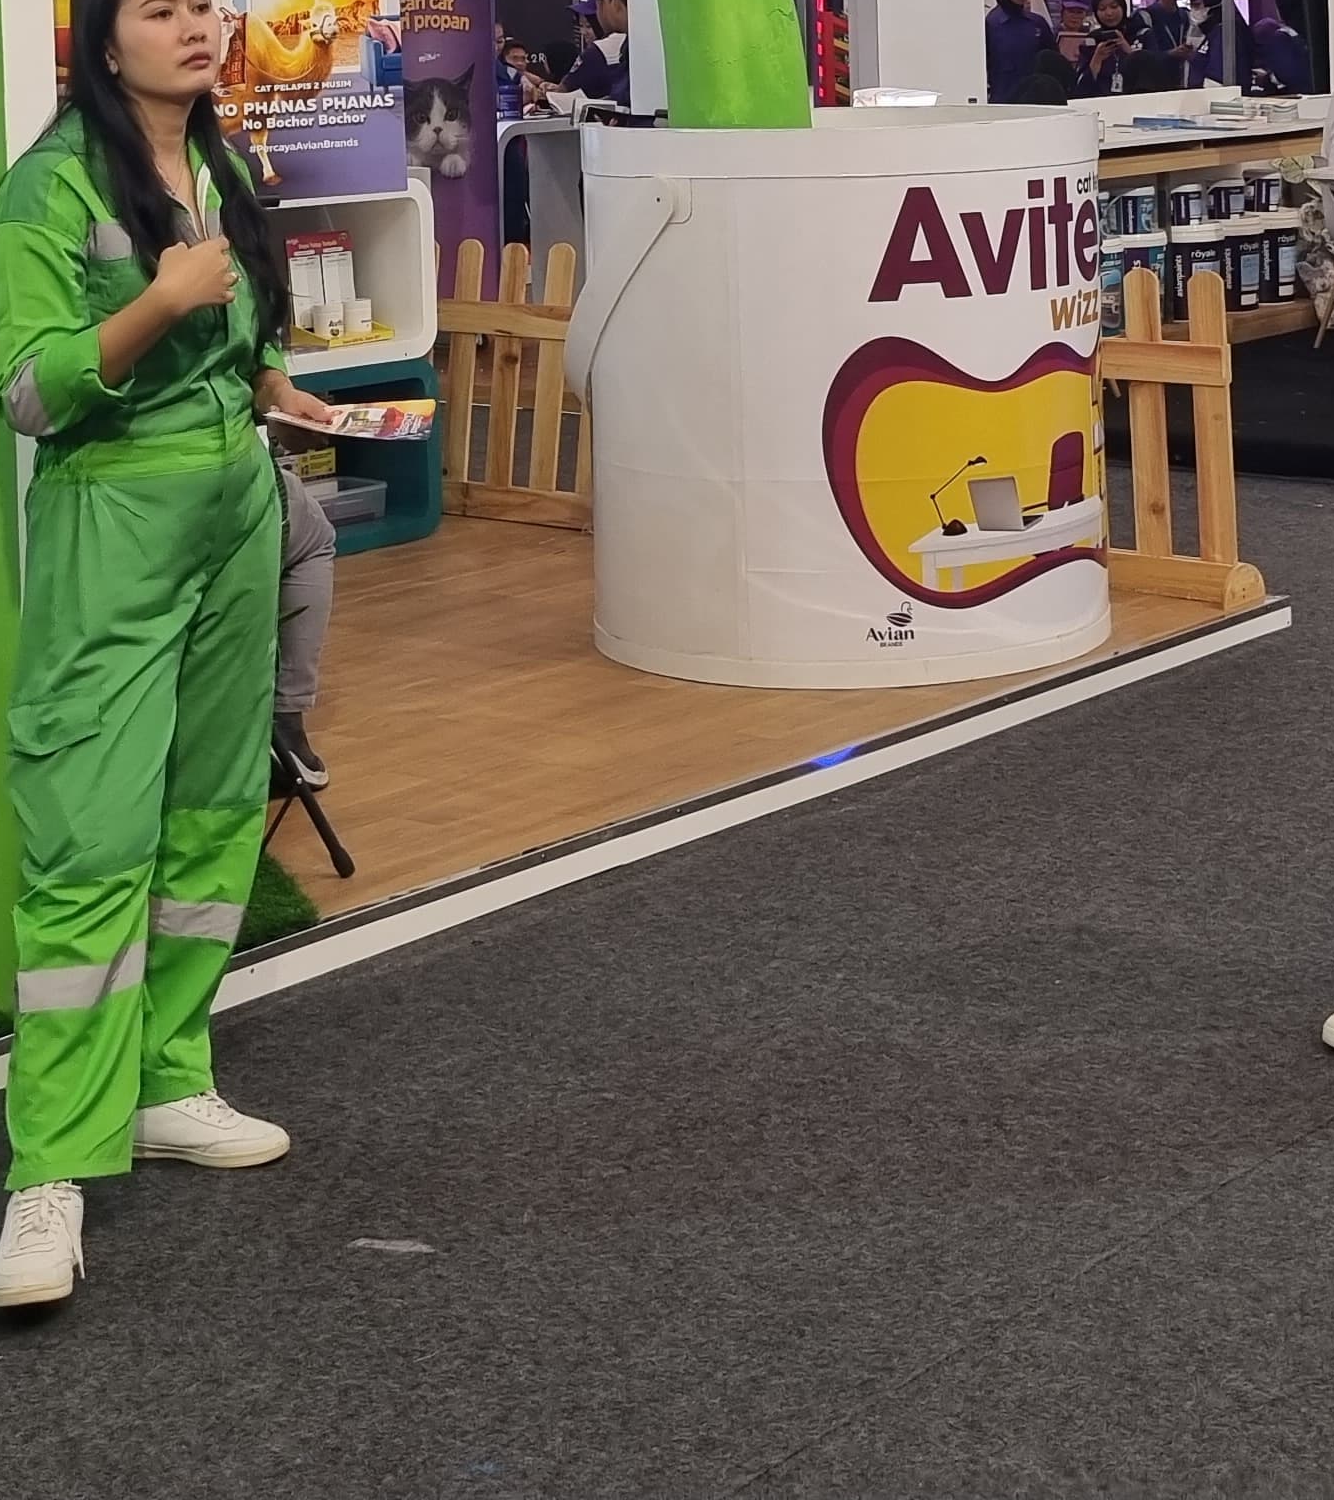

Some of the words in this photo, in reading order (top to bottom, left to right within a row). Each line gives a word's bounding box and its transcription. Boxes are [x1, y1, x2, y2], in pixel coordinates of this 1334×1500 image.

[414, 14, 470, 32] propan
[254, 84, 272, 93] CAT
[274, 83, 312, 92] PELAPIS
[322, 80, 352, 89] MUSIM
[244, 99, 317, 116] PHANAS
[322, 94, 395, 111] PHANAS
[242, 119, 263, 131] No
[266, 115, 315, 129] Bochor
[319, 112, 367, 126] Bochor
[249, 138, 359, 154] #PercayaAvianBrands
[867, 176, 1098, 303] Avite
[866, 627, 914, 641] Avian
